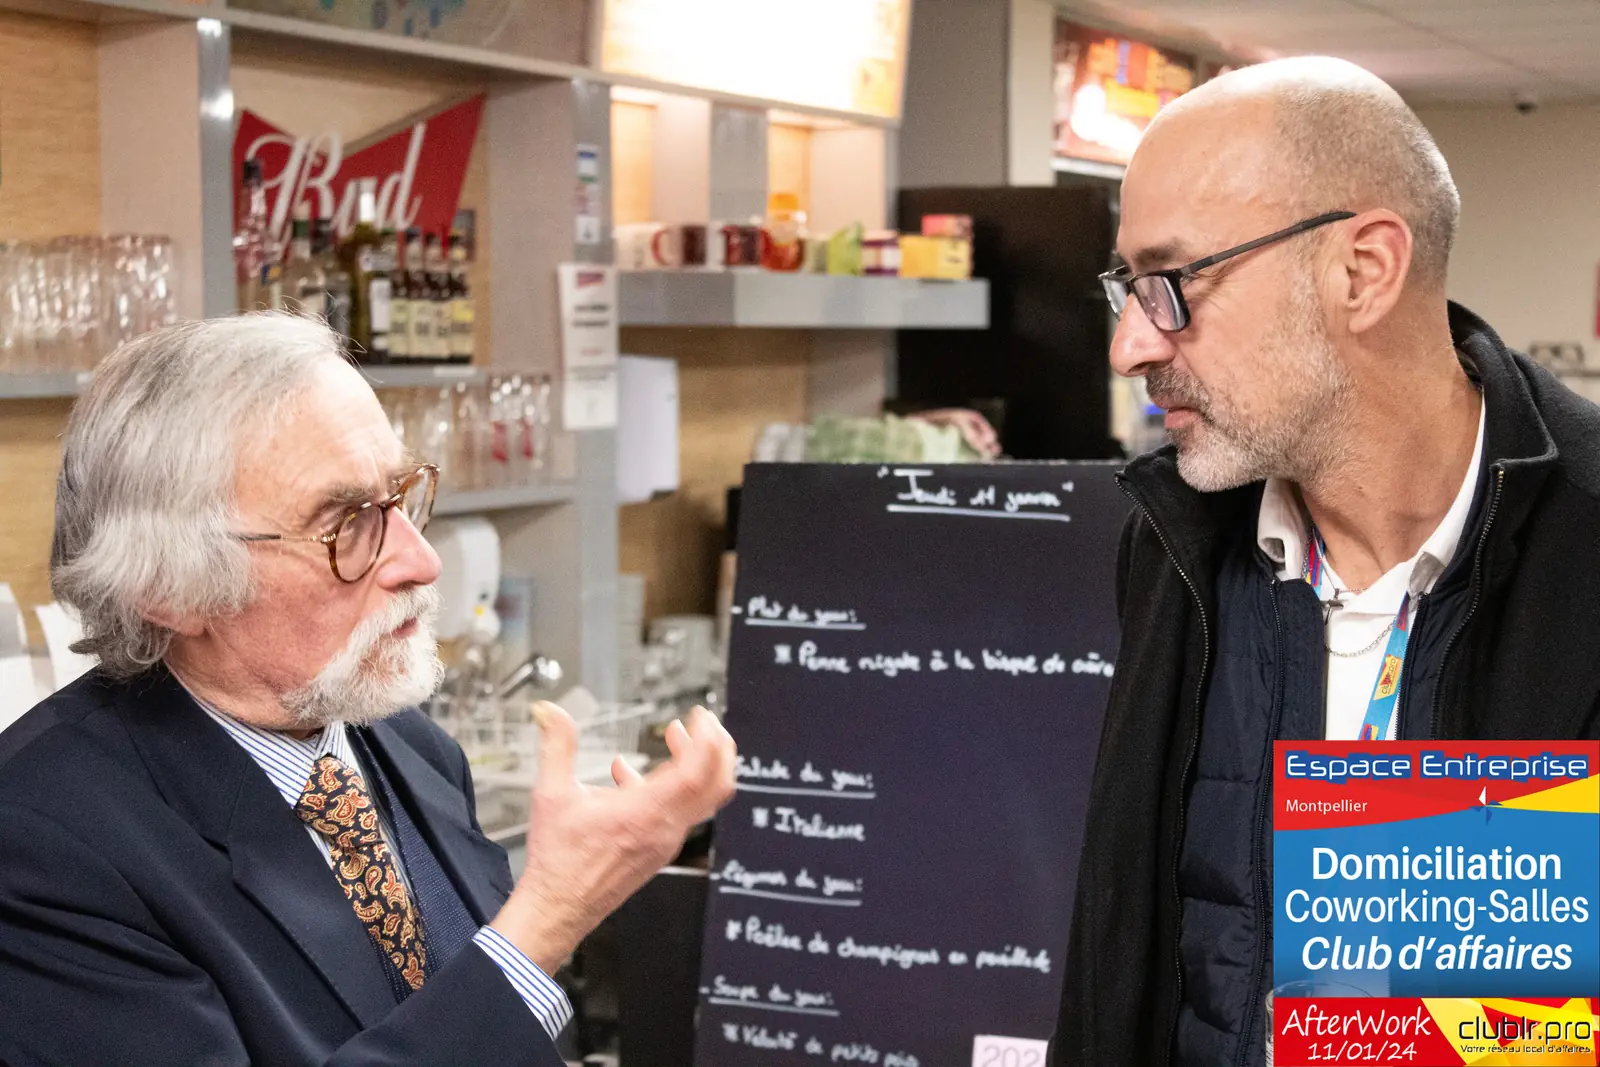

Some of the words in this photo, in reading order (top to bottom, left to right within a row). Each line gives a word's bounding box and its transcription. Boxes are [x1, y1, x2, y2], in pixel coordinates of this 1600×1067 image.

[244, 121, 426, 258] Bud
[955, 650, 974, 671] la
[774, 806, 866, 841] Italienne
